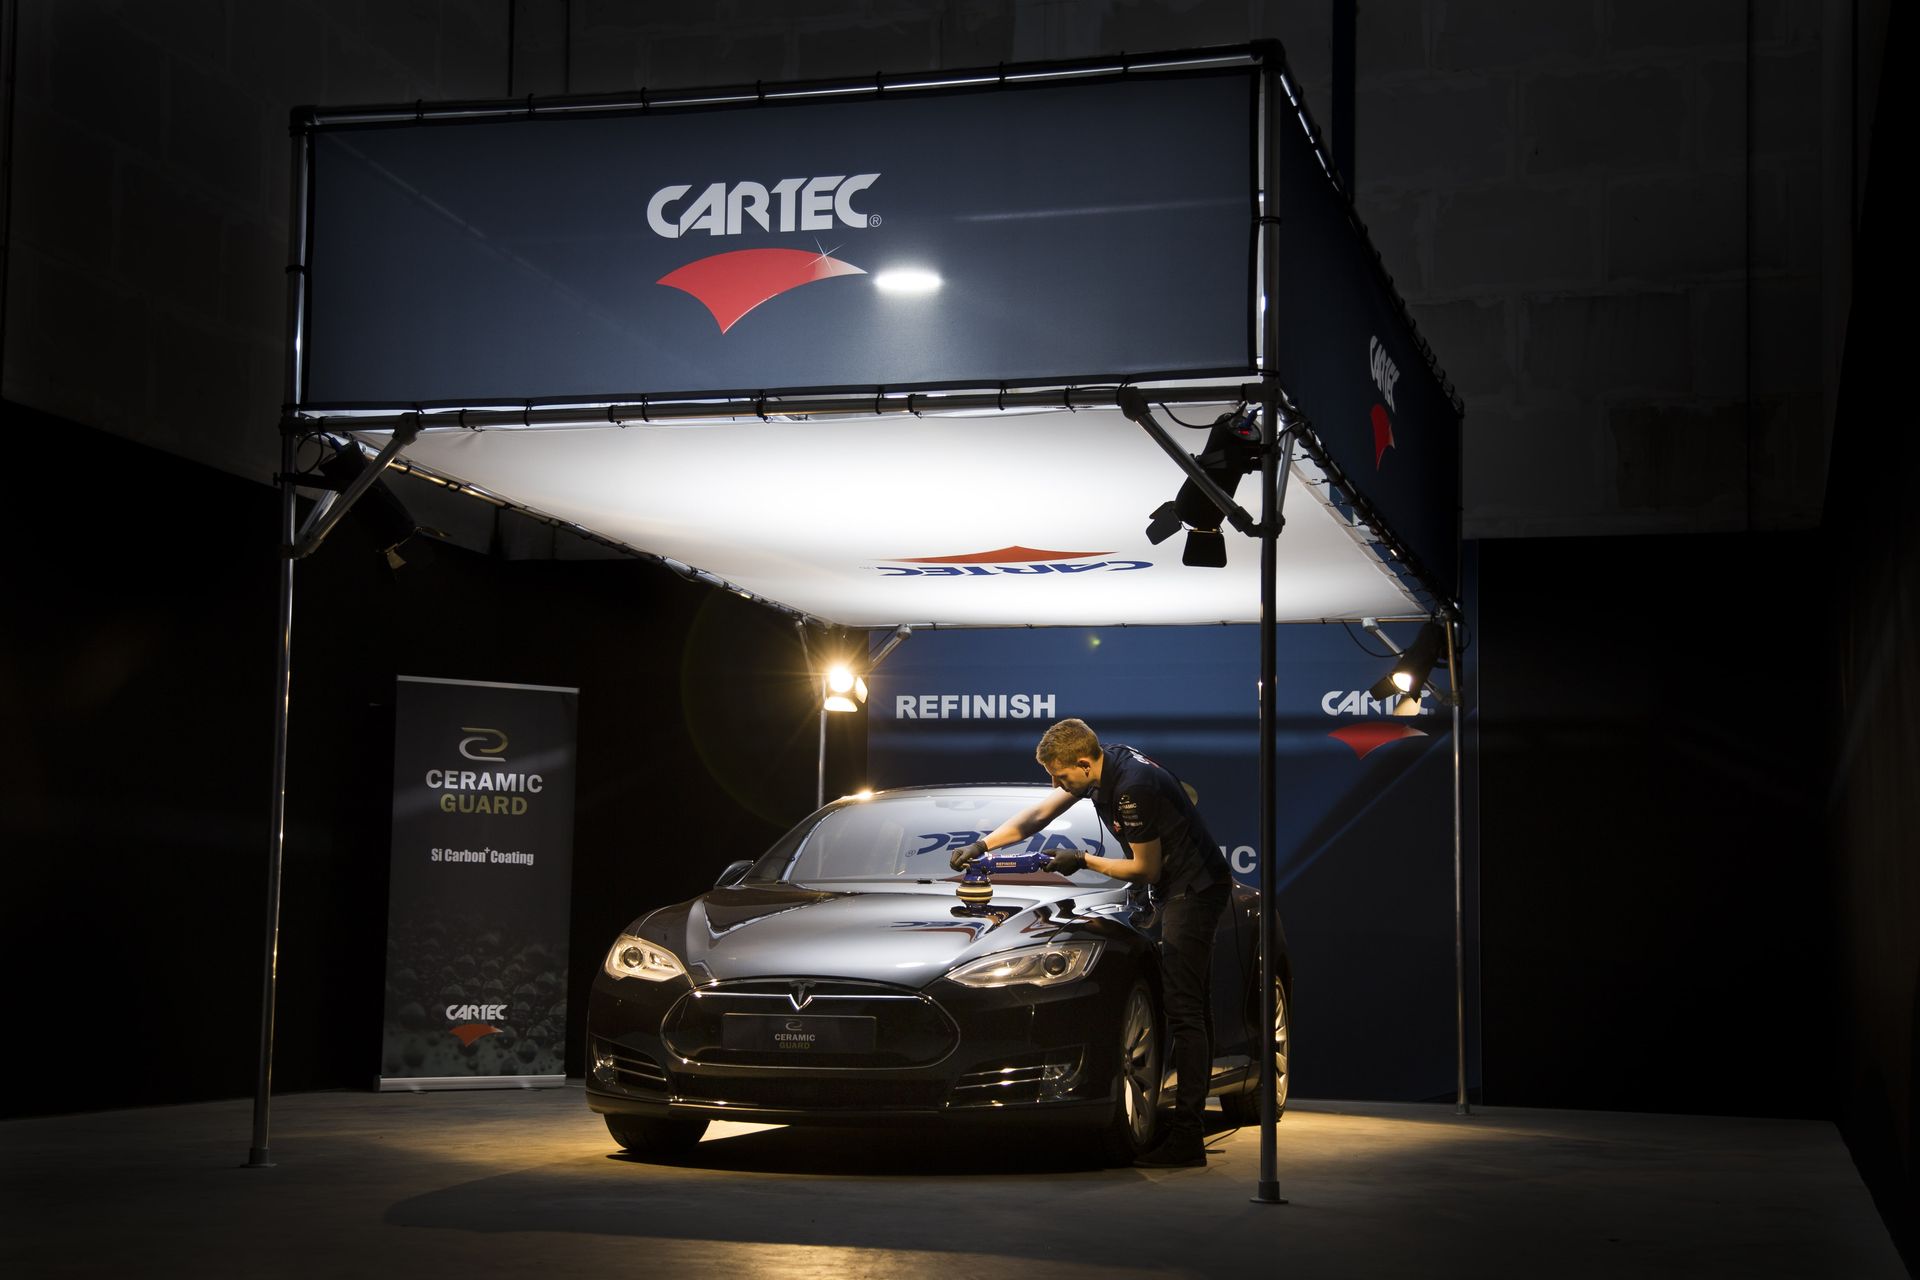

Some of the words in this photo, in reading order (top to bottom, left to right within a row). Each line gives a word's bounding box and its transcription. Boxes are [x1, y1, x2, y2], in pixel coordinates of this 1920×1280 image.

[895, 694, 1056, 719] REFINISH
[1321, 690, 1432, 717] CART
[425, 769, 543, 794] CERAMIC
[440, 793, 529, 816] GUARD
[431, 848, 442, 862] Si
[490, 850, 534, 866] Coating
[445, 1004, 508, 1021] CARTEC
[774, 1033, 816, 1042] CERAMIC
